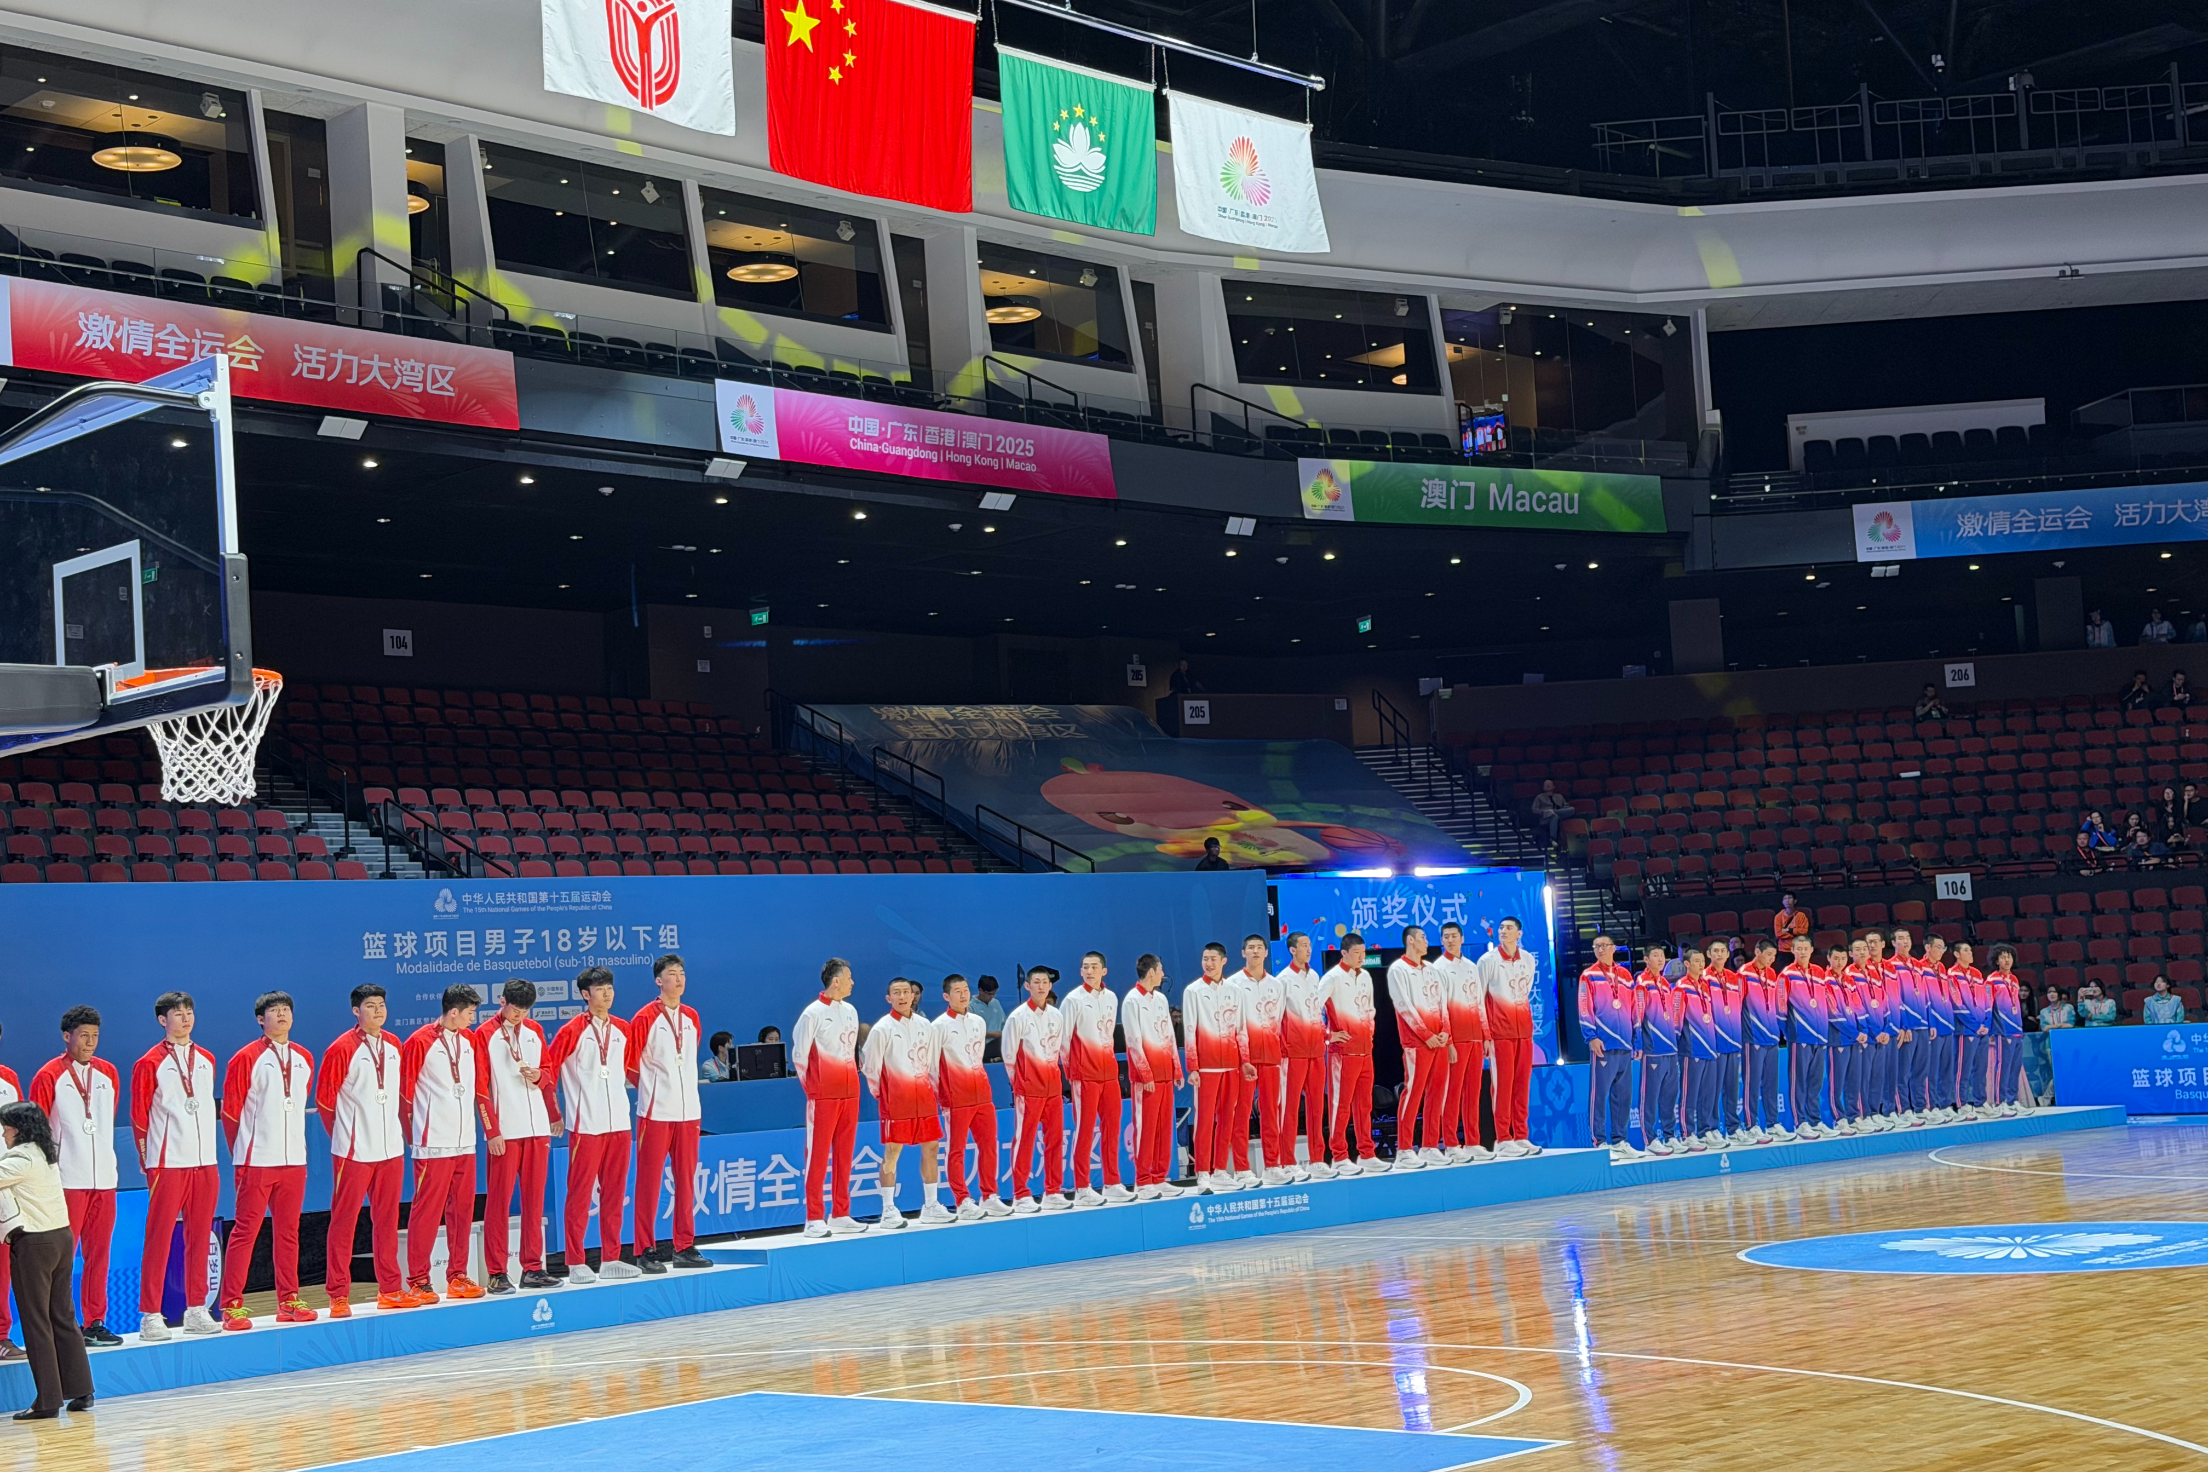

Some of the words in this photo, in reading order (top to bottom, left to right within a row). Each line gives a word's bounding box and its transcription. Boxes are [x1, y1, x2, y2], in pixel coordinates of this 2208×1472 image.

[75, 311, 265, 372] 激情全运会
[291, 343, 456, 396] 活力大湾区
[996, 435, 1035, 457] 2025
[945, 452, 972, 467] Hong
[974, 454, 999, 470] Kong
[1005, 458, 1037, 472] Macao
[1420, 478, 1476, 511] 澳门
[1489, 483, 1579, 515] Macau
[1955, 505, 2093, 539] 激情全运会
[389, 634, 408, 651] 104
[1950, 668, 1970, 683] 206
[1189, 705, 1206, 719] 205
[461, 889, 613, 906] 中华人民共和国第十五届运动会
[1943, 880, 1967, 896] 106
[462, 906, 474, 914] The
[487, 905, 510, 913] National
[510, 905, 526, 913] Games
[536, 904, 546, 912] the
[568, 904, 591, 912] Republic
[597, 903, 613, 911] China
[1351, 892, 1468, 930] 颁奖仪式
[362, 924, 681, 960] 篮球项目男子18岁以下组
[396, 958, 464, 975] Modalidade
[466, 958, 481, 972] de
[483, 956, 552, 974] Basquetebol
[554, 955, 596, 971] (sub-18
[597, 953, 655, 967] masculino)
[1206, 1193, 1310, 1216] 中华人民共和国第十五届运动会
